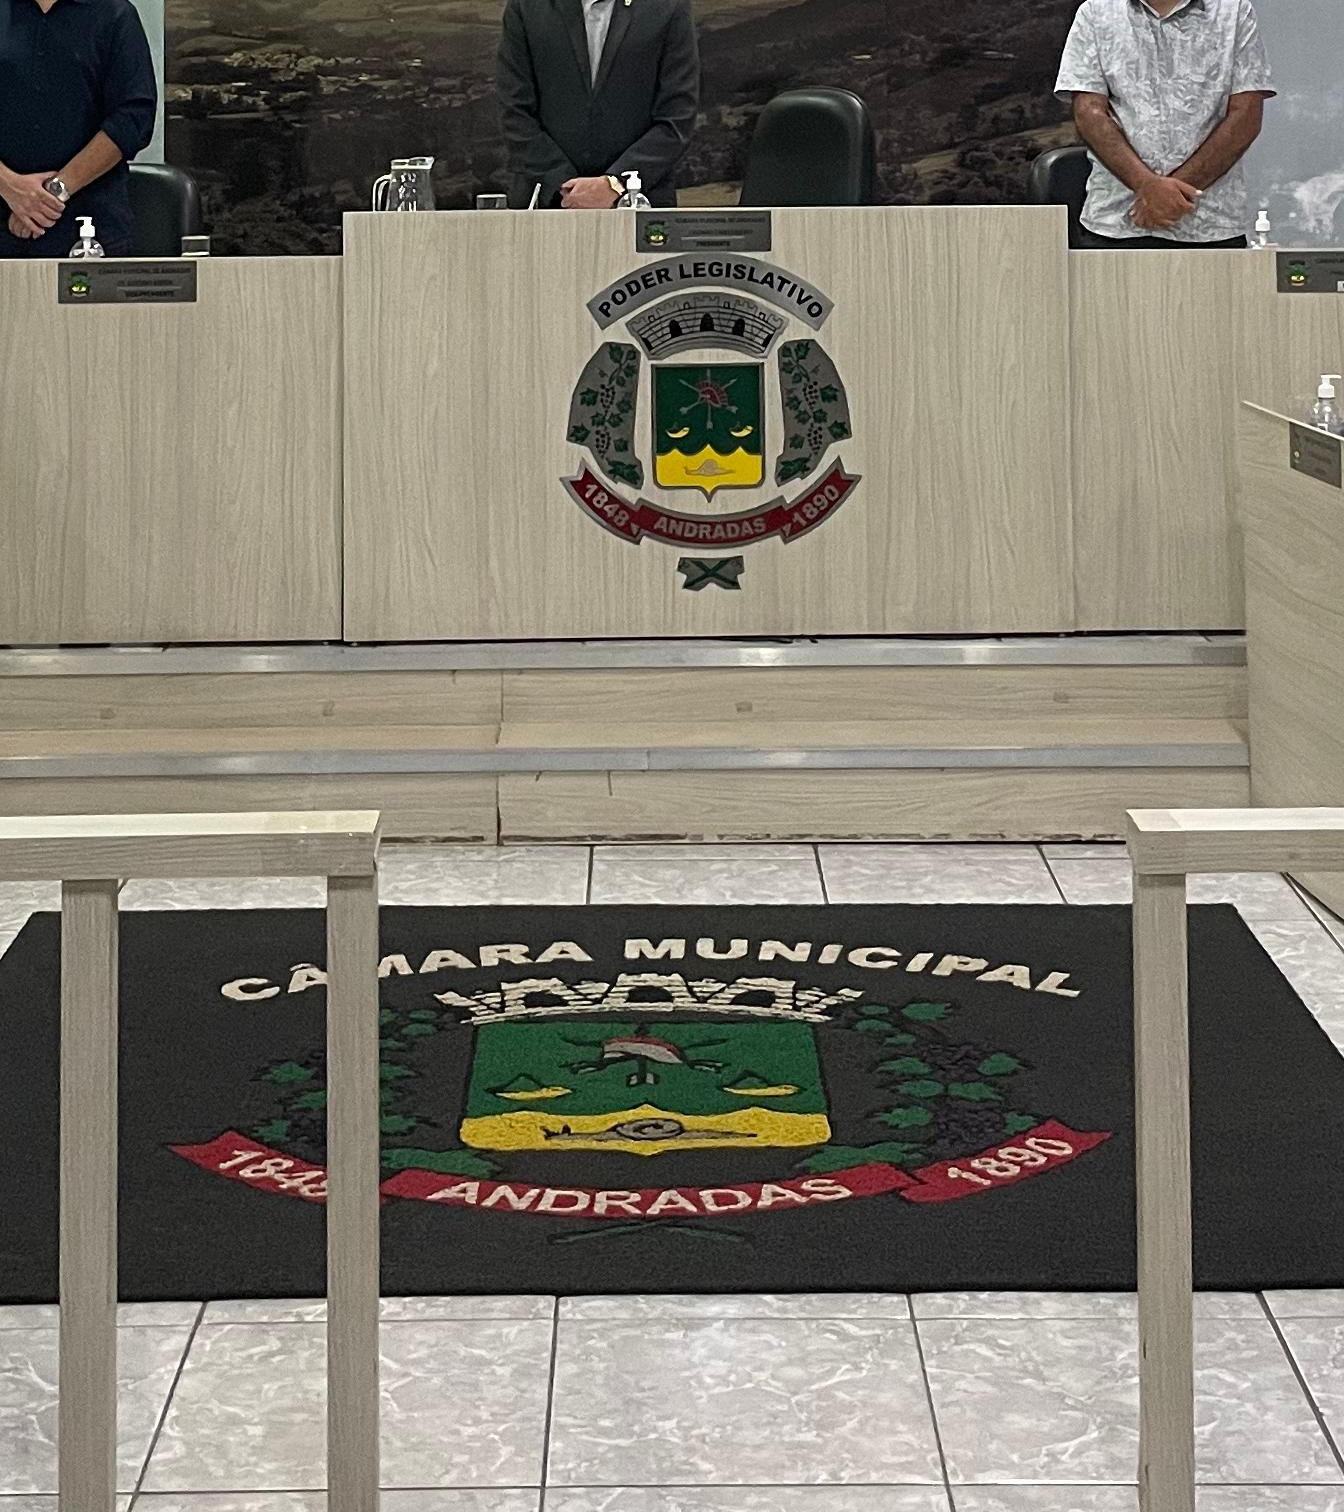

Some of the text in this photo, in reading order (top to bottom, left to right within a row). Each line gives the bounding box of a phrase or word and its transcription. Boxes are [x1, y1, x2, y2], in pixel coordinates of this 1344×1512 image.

[598, 261, 824, 319] PODER LEGISLATIVO
[584, 483, 630, 527] 1848
[791, 484, 840, 528] 1890
[654, 516, 767, 540] ANDRADAS
[623, 938, 1081, 999] MUNICIPAL
[947, 1136, 1073, 1187] 1890
[446, 1178, 853, 1218] ANDRADAS
